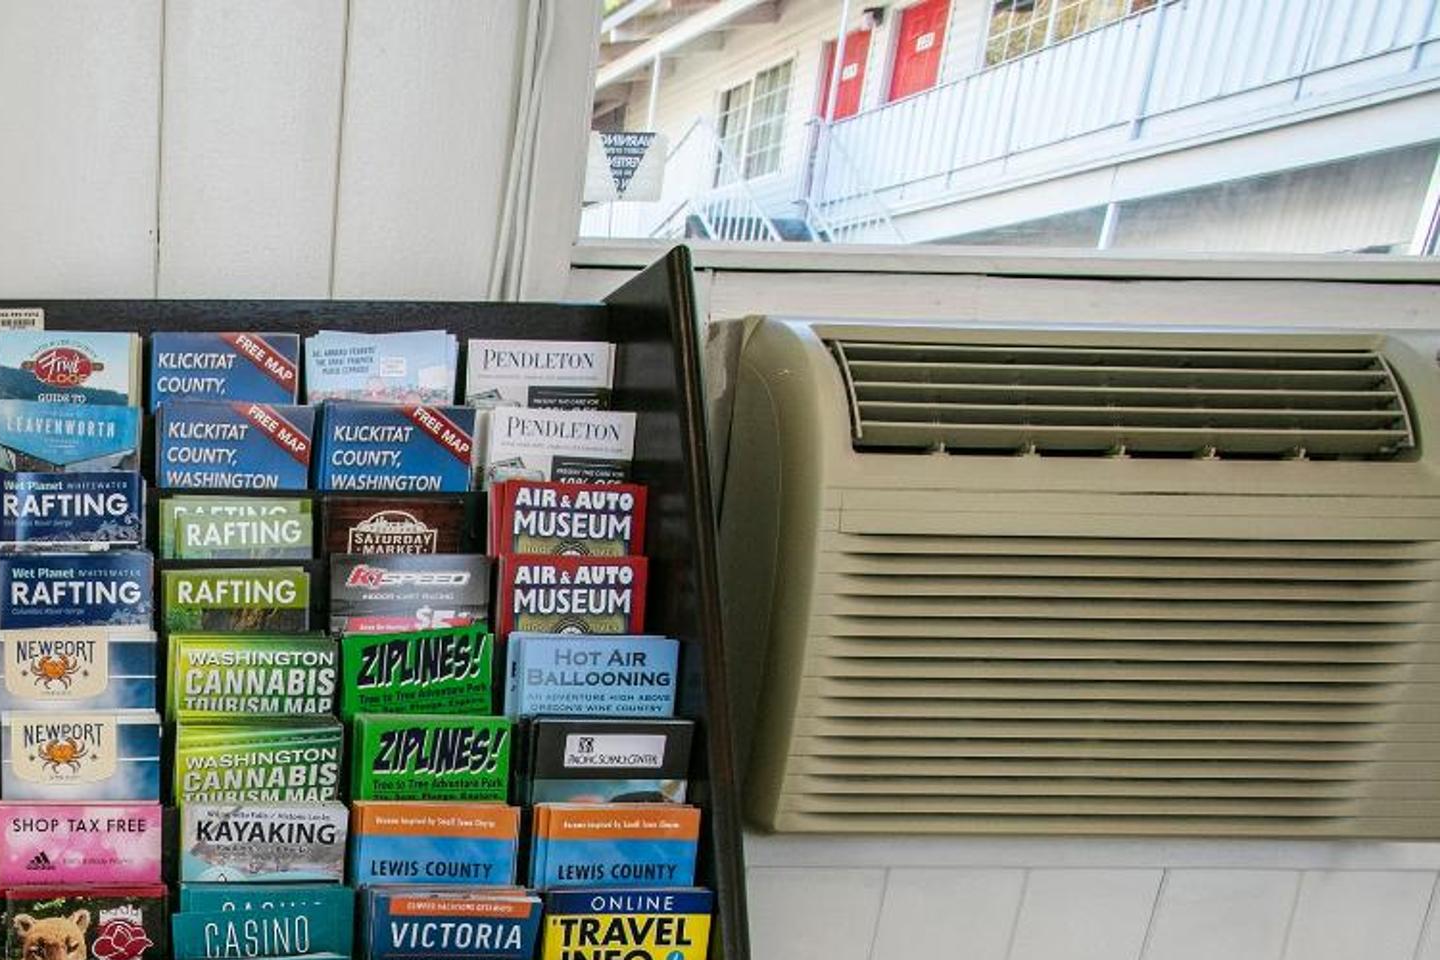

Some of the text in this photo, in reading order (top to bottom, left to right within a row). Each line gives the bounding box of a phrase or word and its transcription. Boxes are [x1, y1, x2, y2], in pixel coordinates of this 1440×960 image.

[158, 352, 237, 369] KLICKITAT
[235, 335, 264, 364] FREE
[264, 357, 294, 382] MAP
[483, 348, 595, 370] PENDLETON
[157, 377, 227, 396] COUNTY,
[168, 423, 248, 440] KLICKITAT
[247, 405, 306, 453] FREE MAP
[167, 448, 238, 466] COUNTY,
[167, 472, 278, 489] WASHINGTON
[3, 493, 129, 518] RAFTING
[515, 487, 634, 511] AIR & AUTO
[514, 513, 631, 540] MUSEUM
[354, 532, 432, 546] SATURDAY
[12, 568, 35, 578] Wet
[38, 567, 75, 579] Planet
[12, 581, 142, 606] RAFTING
[178, 580, 297, 605] RAFTING
[16, 640, 96, 664] NEWPORT
[188, 652, 334, 666] WASHINGTON
[185, 668, 335, 695] CANNABIS
[527, 669, 671, 686] BALLOONING
[185, 698, 332, 714] TOURISM MAP
[372, 727, 507, 777] ZIPLINES!
[13, 818, 147, 833] SHOP TAX FREE
[196, 820, 336, 845] KAYAKING
[371, 860, 493, 878] LEWIS COUNTY
[591, 896, 675, 911] ONLINE
[391, 922, 521, 949] VICTORIA
[560, 918, 692, 947] TRAVEL
